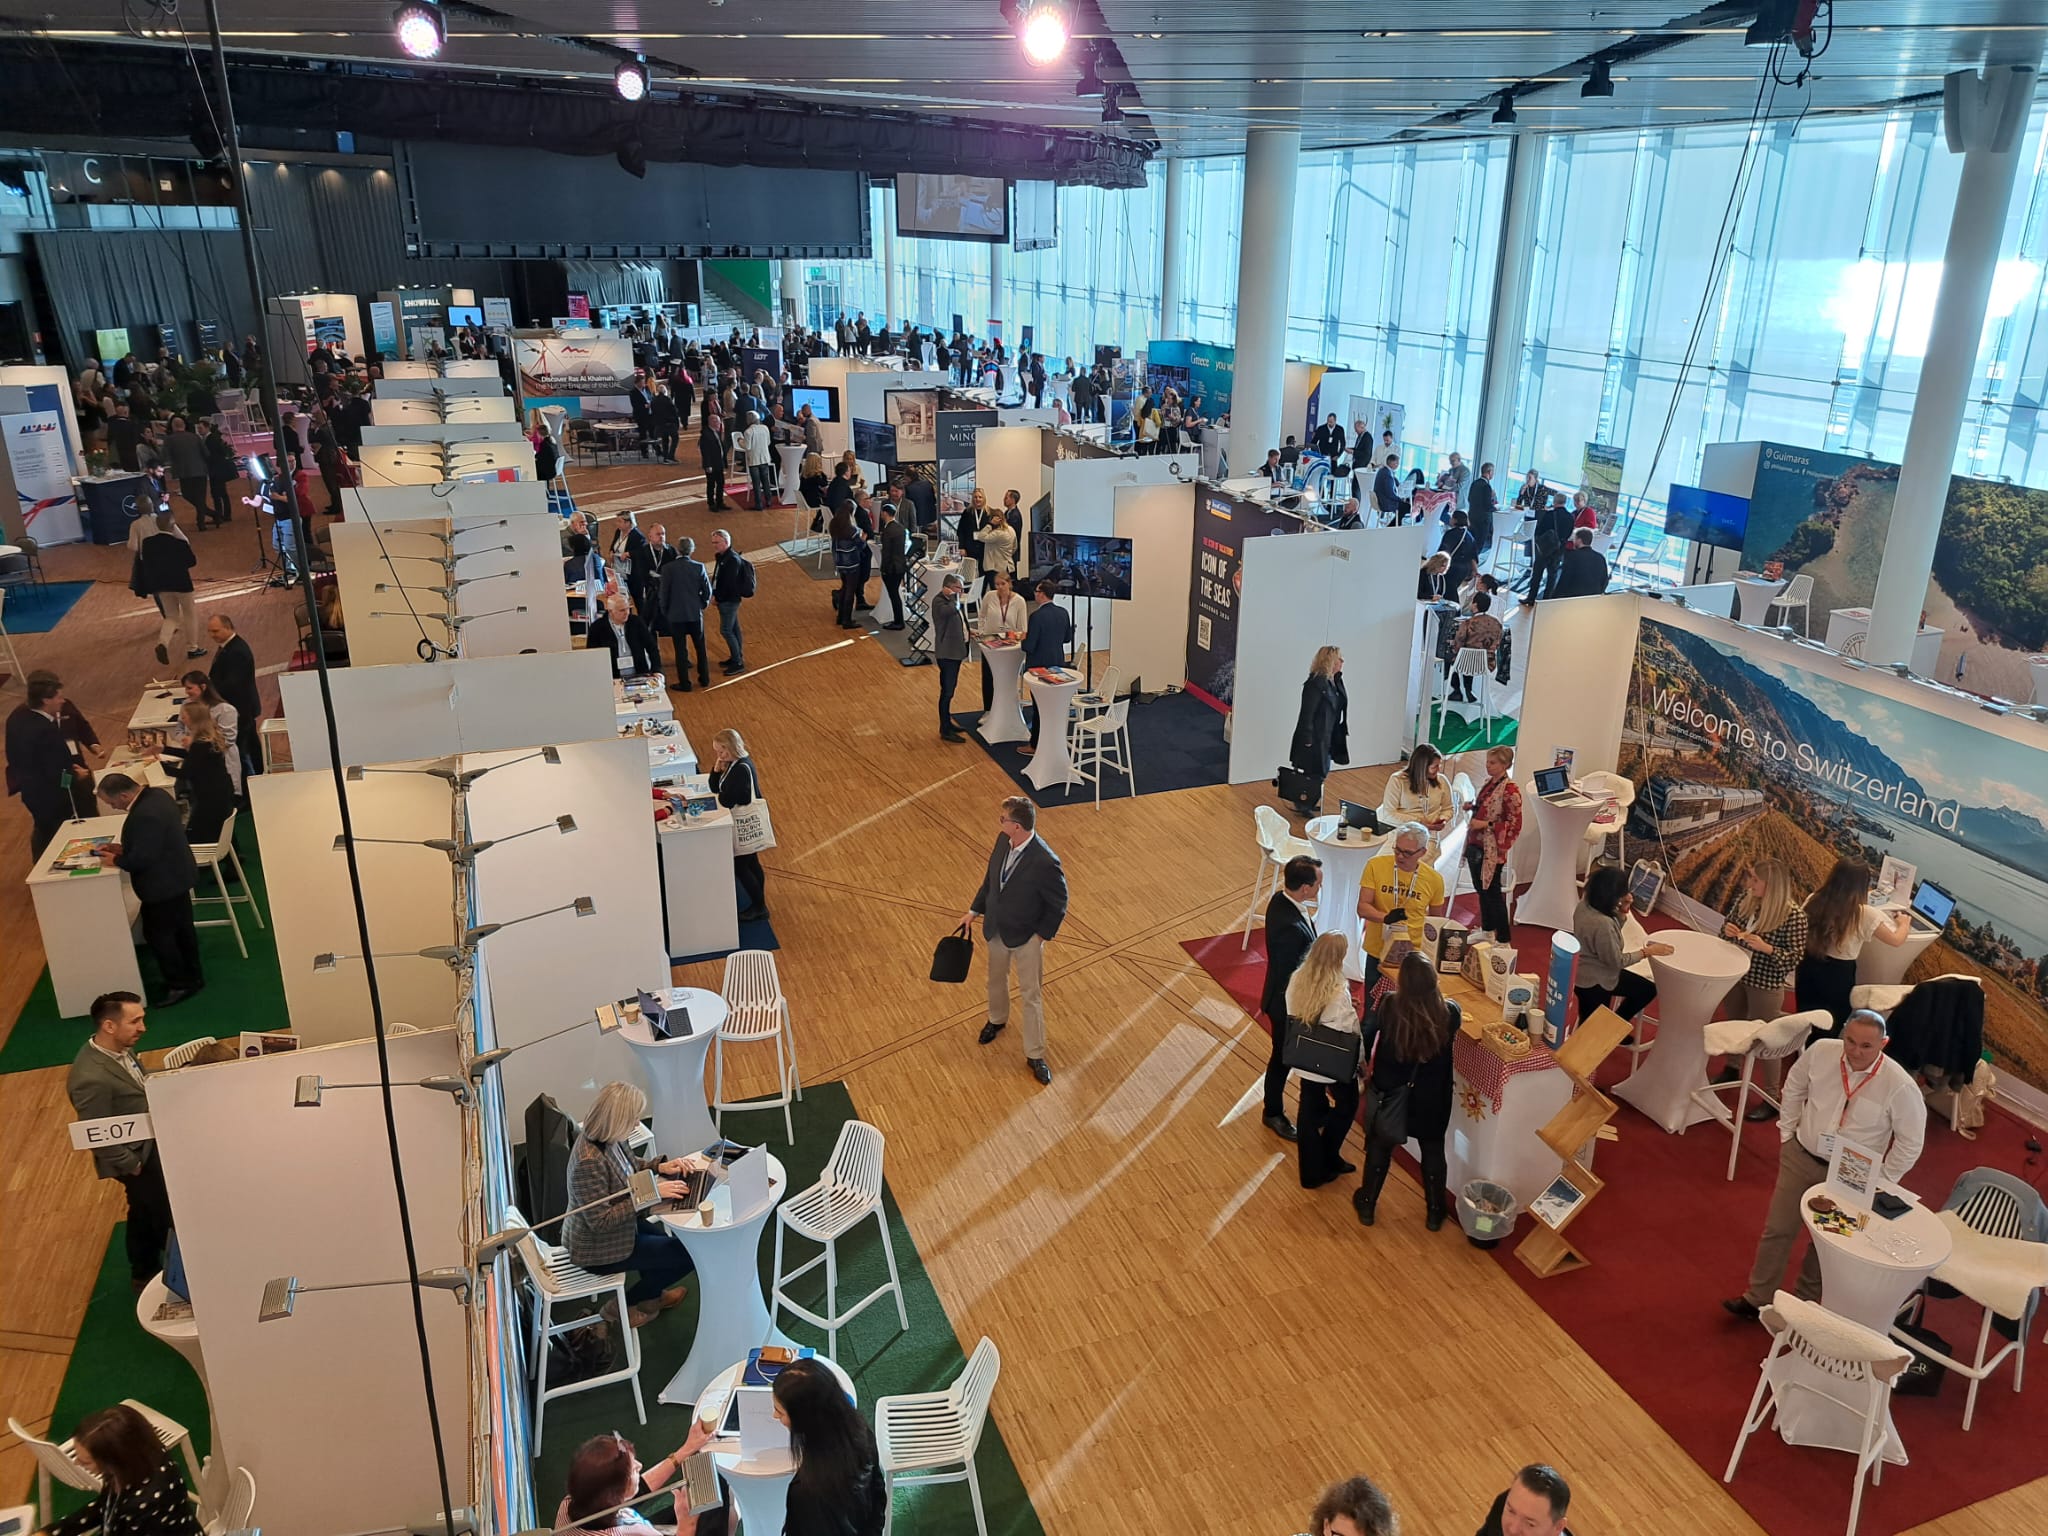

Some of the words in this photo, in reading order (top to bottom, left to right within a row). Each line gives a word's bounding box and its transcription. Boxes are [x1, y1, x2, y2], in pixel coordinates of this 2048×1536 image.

[83, 158, 102, 184] C
[1190, 352, 1209, 367] Greece
[541, 375, 567, 383] Discover
[1773, 450, 1809, 466] Guimaras
[1202, 551, 1217, 576] ICON
[1218, 559, 1228, 580] OF
[1201, 576, 1212, 599] THE
[1213, 583, 1231, 608] SEAS
[1652, 686, 1755, 748] Welcome
[1763, 731, 1787, 761] to
[1795, 743, 1965, 837] Switzerland.
[736, 815, 760, 824] TRAVEL
[738, 831, 763, 842] RICHER
[86, 1121, 136, 1143] E:07
